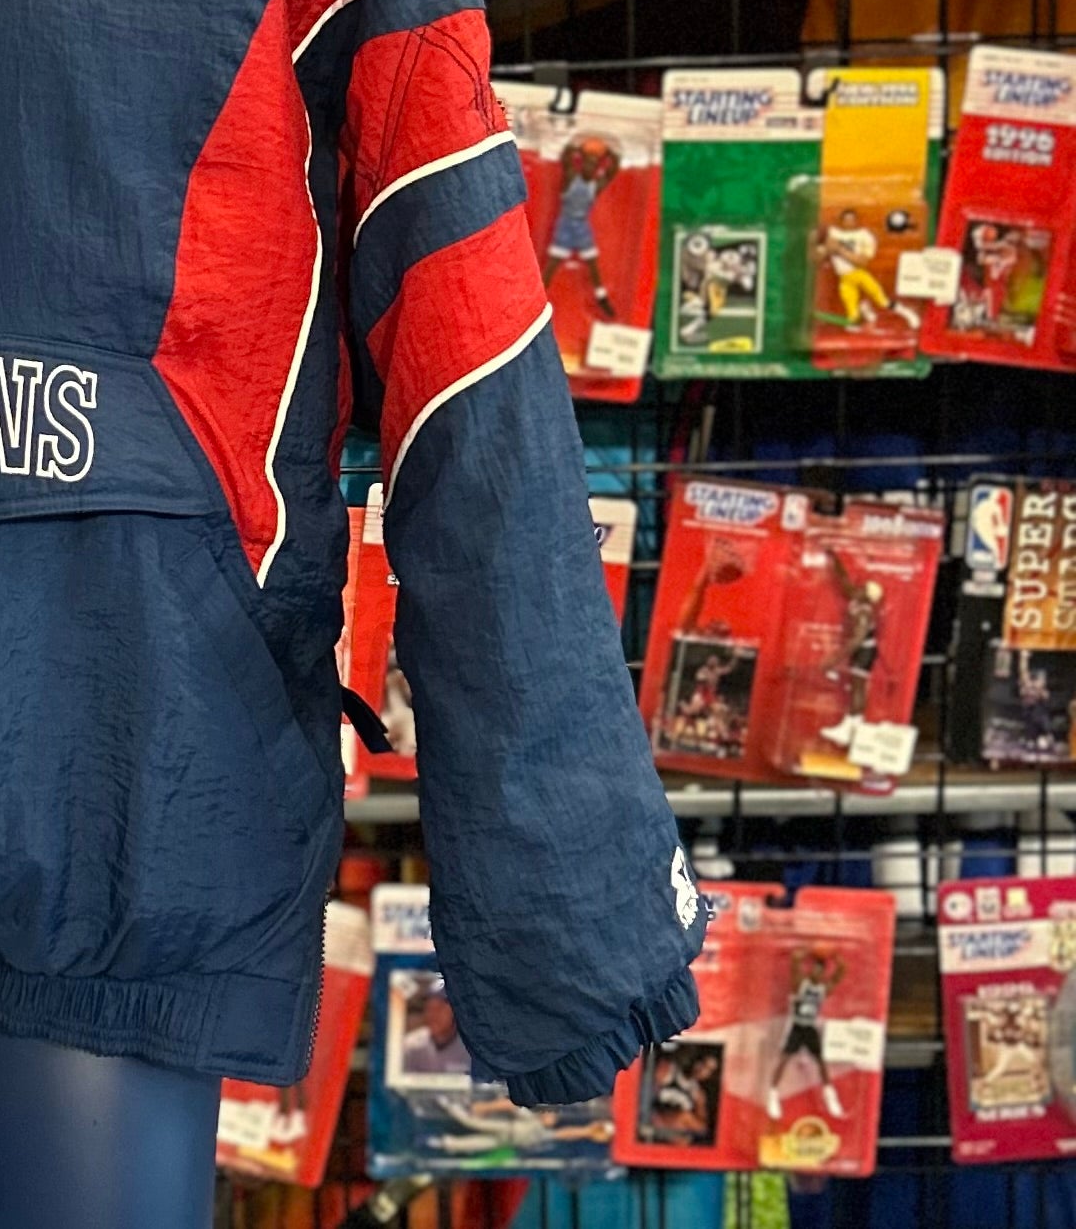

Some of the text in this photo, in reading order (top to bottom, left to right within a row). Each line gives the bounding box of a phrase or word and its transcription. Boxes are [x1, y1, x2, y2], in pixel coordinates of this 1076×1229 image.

[673, 89, 772, 109] STARTING
[687, 104, 760, 126] LINEUP
[985, 123, 1057, 153] 1996
[688, 483, 776, 510] STARTING
[1011, 490, 1058, 631] SUPER
